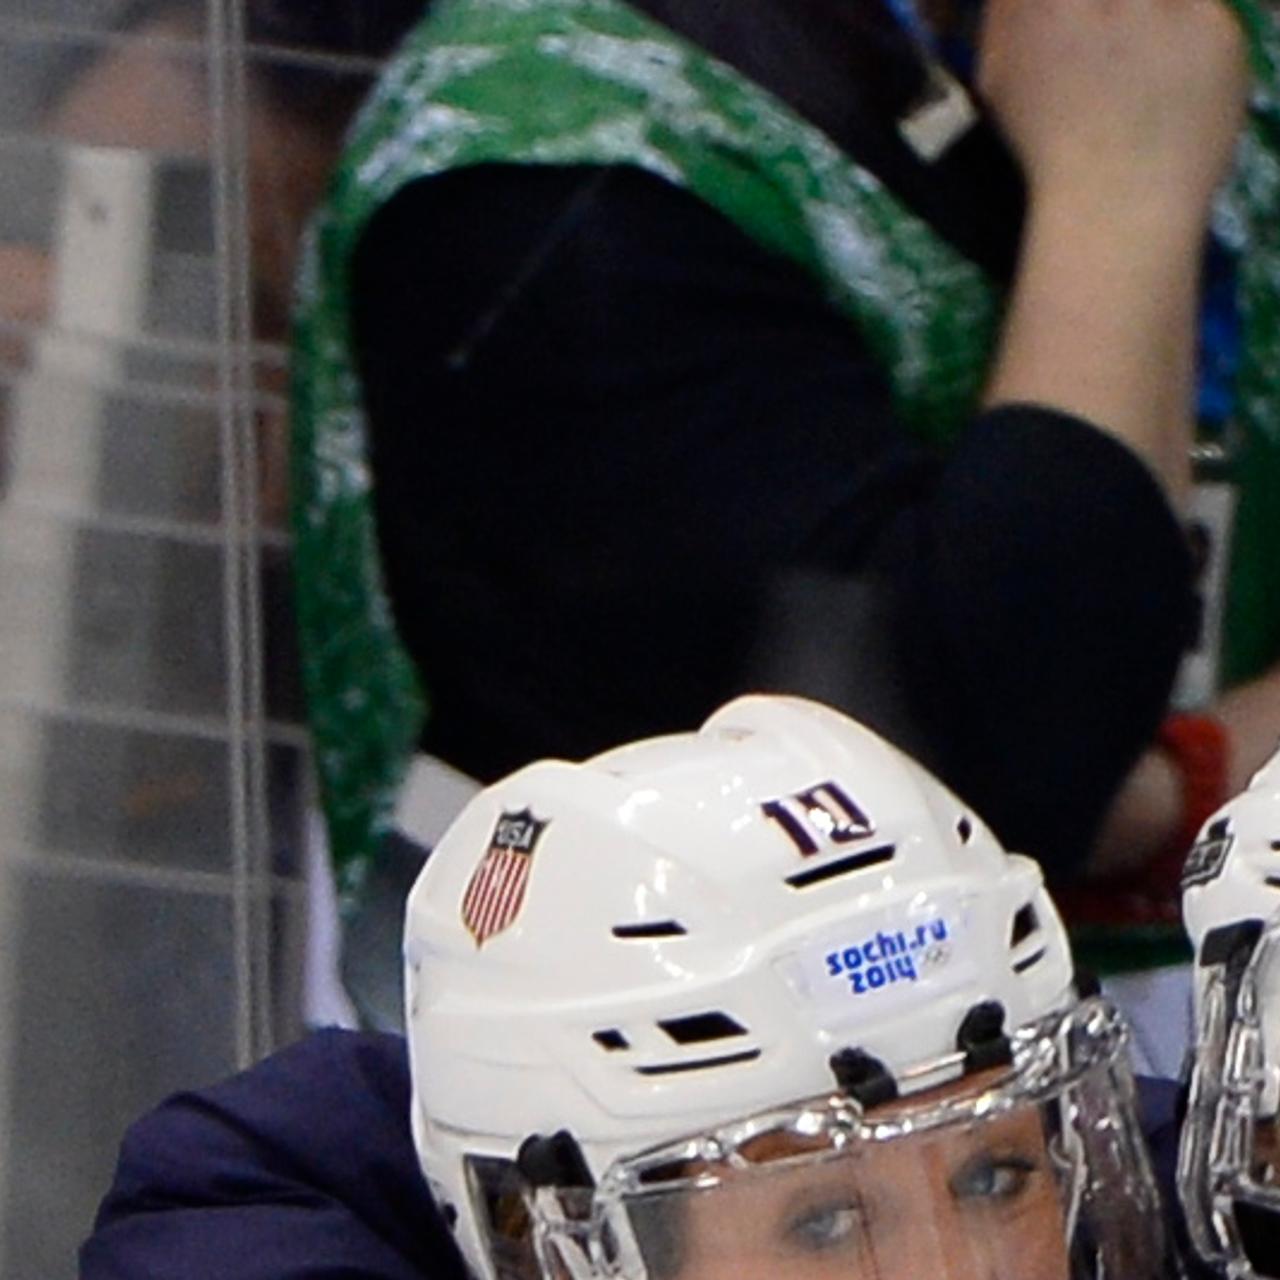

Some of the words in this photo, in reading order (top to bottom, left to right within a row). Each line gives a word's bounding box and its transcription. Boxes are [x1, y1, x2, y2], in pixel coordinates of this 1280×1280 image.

[760, 778, 876, 858] 10
[825, 917, 948, 976] sochi.ru
[848, 954, 918, 995] 2014
